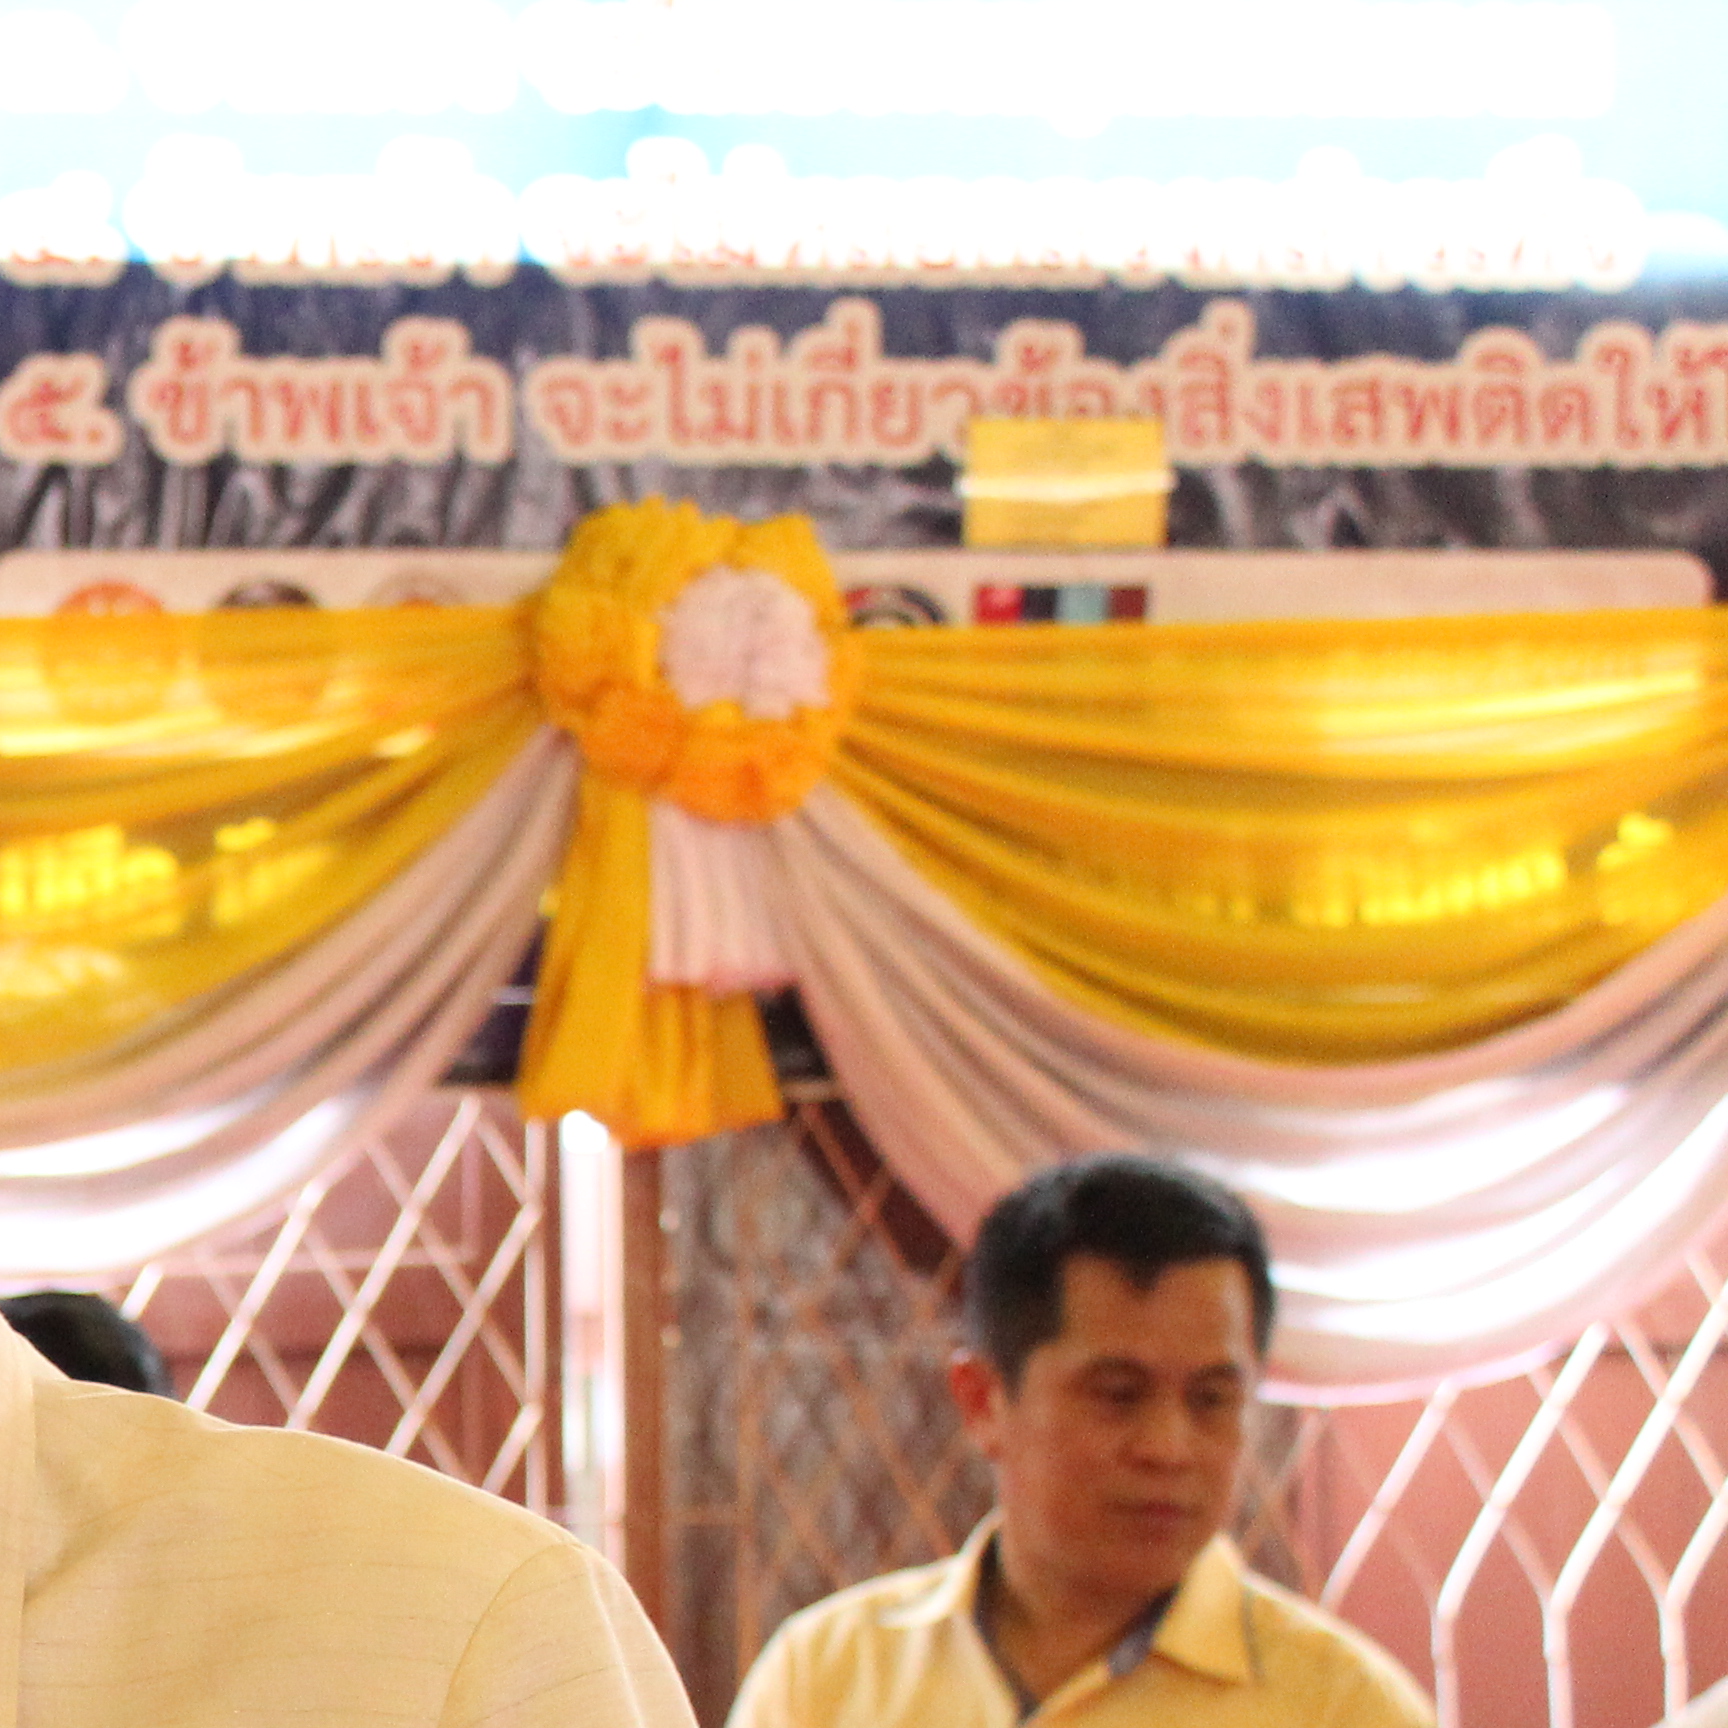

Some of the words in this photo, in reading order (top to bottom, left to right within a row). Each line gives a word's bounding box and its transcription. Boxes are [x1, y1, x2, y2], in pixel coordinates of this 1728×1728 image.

[0, 368, 107, 449] ๕.
[142, 334, 500, 448] ข้าพเจ้า
